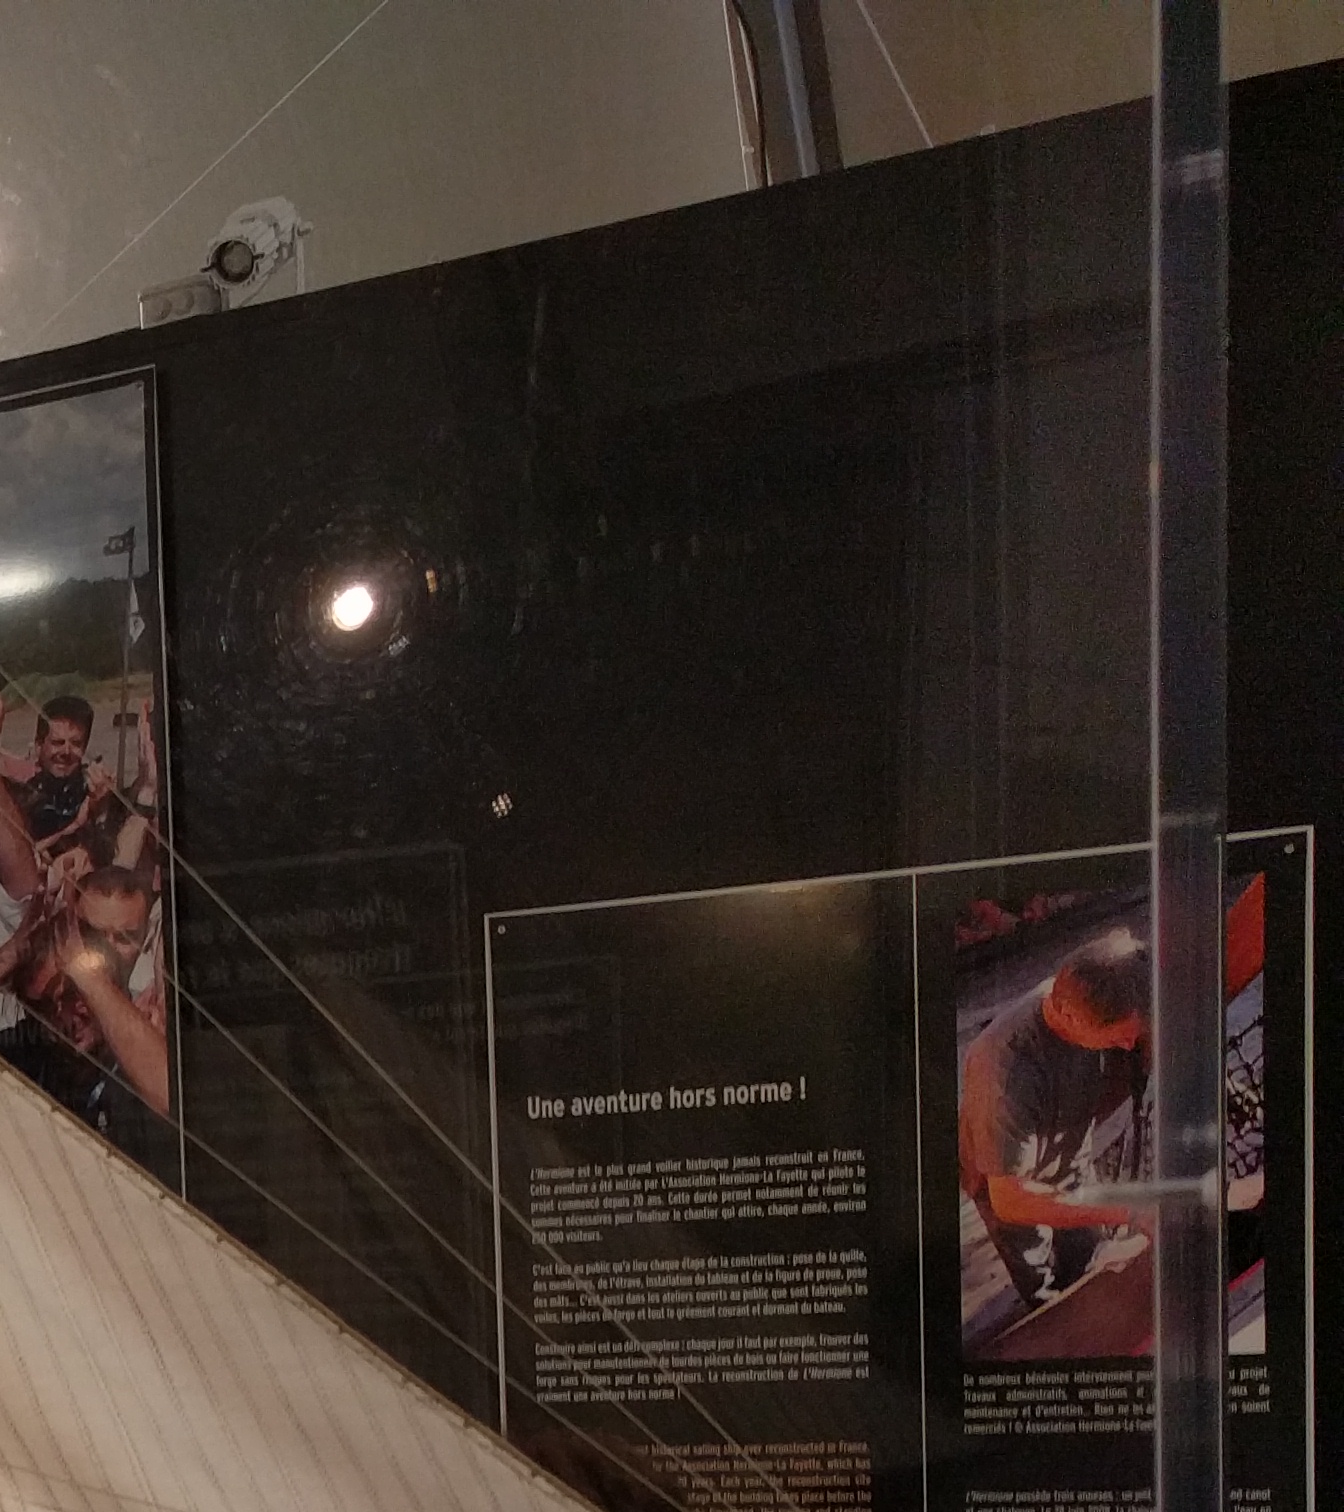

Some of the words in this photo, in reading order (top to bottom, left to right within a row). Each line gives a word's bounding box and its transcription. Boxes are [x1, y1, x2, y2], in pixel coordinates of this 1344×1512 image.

[527, 1096, 565, 1119] Une
[571, 1089, 662, 1116] aventure
[669, 1086, 716, 1109] hors
[723, 1082, 792, 1105] norme
